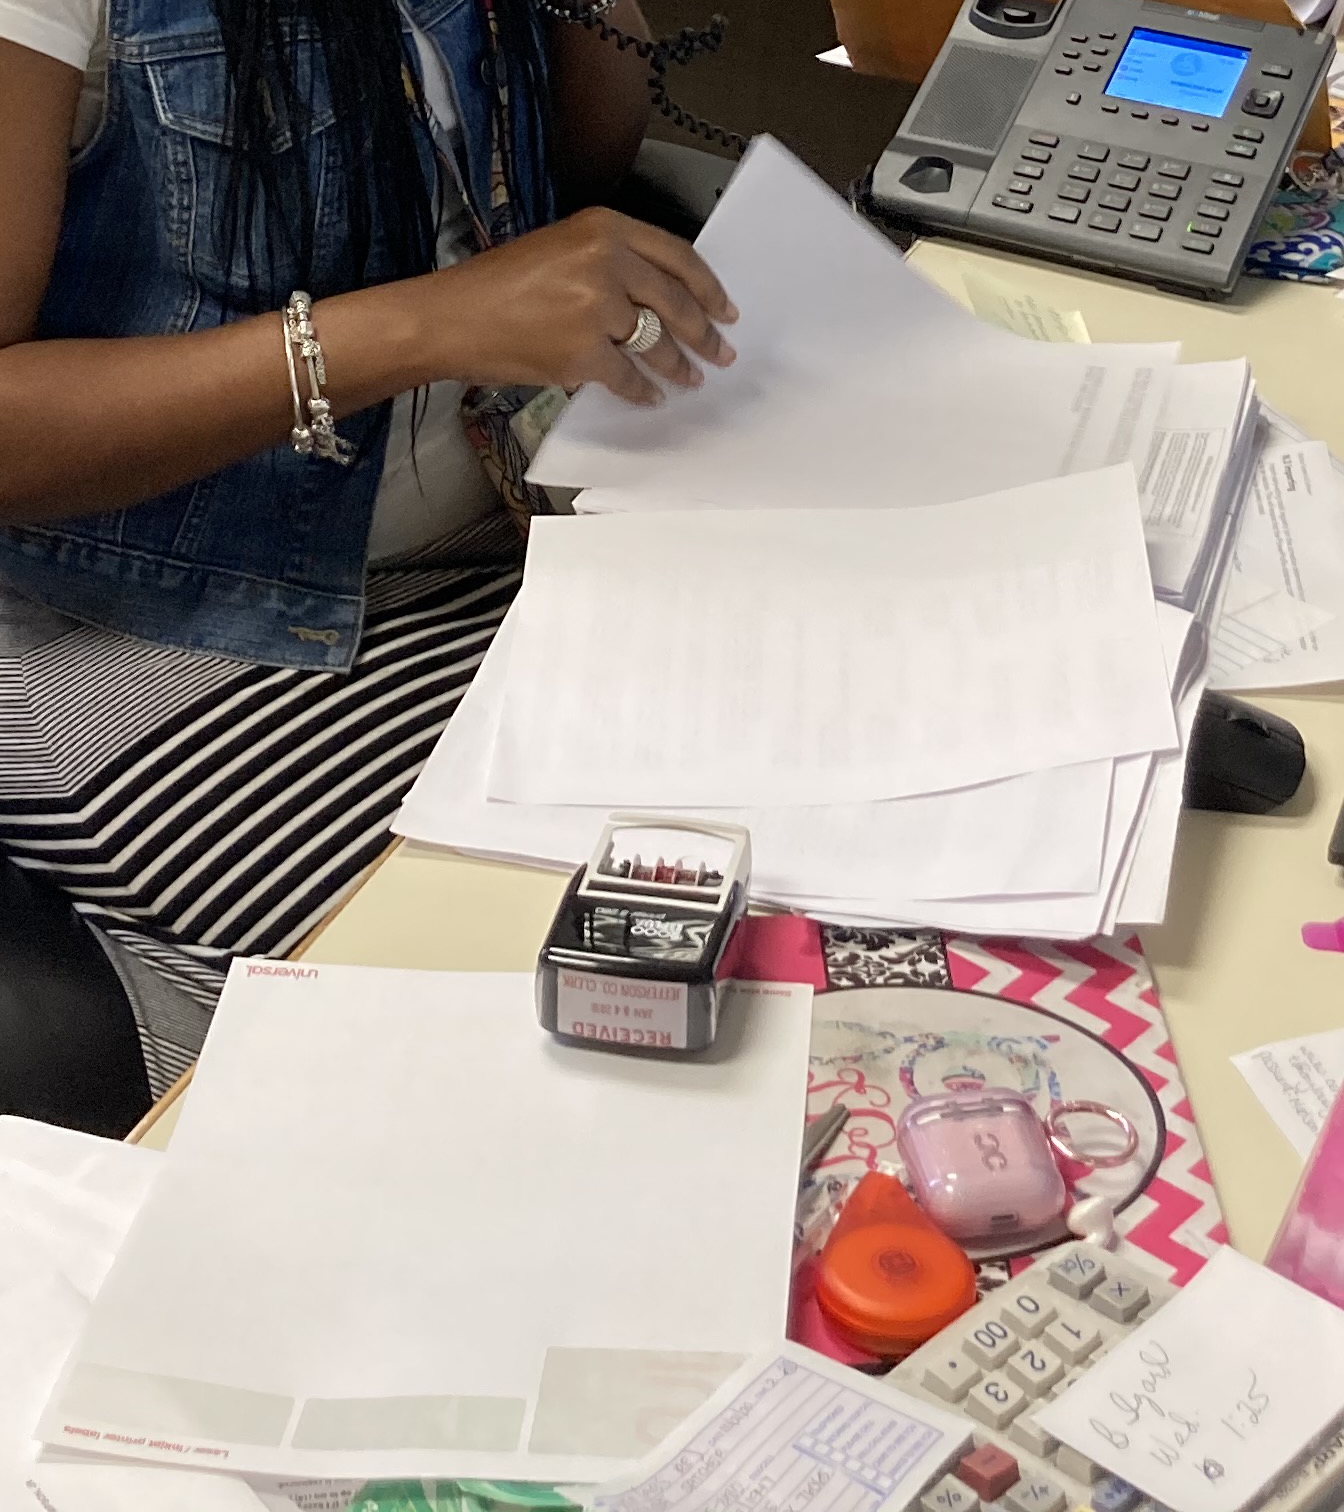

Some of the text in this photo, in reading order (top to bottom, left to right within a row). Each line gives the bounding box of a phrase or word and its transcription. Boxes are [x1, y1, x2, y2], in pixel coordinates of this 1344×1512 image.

[562, 973, 597, 992] CLERK
[621, 985, 681, 1001] JEFFERSON
[572, 1021, 673, 1047] RECEIVED
[1020, 1349, 1047, 1373] 2
[984, 1381, 1010, 1404] 3
